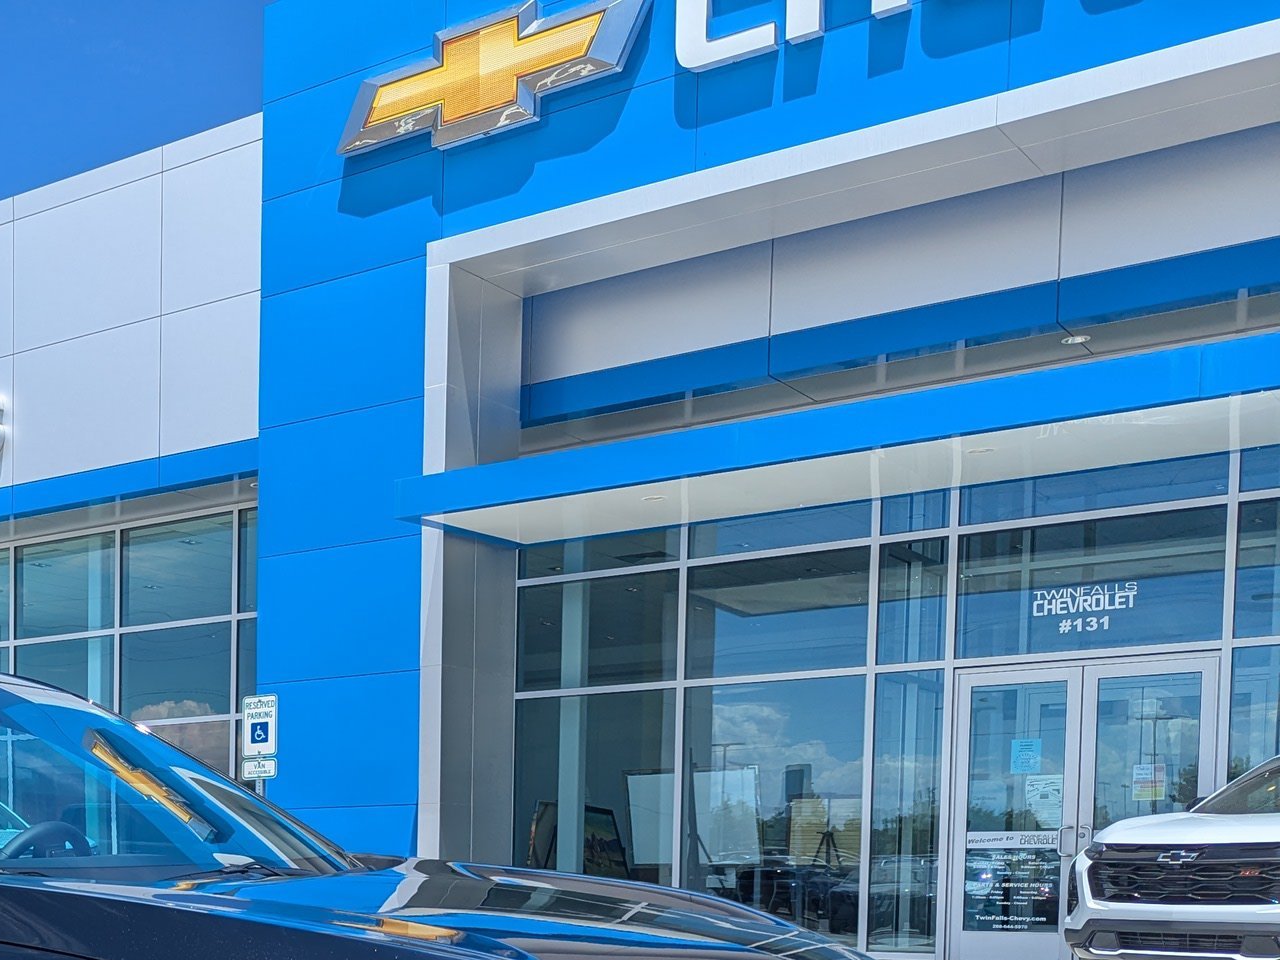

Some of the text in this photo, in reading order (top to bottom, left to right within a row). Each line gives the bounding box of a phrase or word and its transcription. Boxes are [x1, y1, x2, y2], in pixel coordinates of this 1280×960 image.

[1033, 582, 1137, 600] TWINFALLS
[1032, 592, 1137, 616] CHEVROLET
[1059, 616, 1109, 633] #131
[245, 700, 275, 710] RESERVED
[246, 711, 273, 720] PARKING
[968, 836, 1004, 845] Welcome
